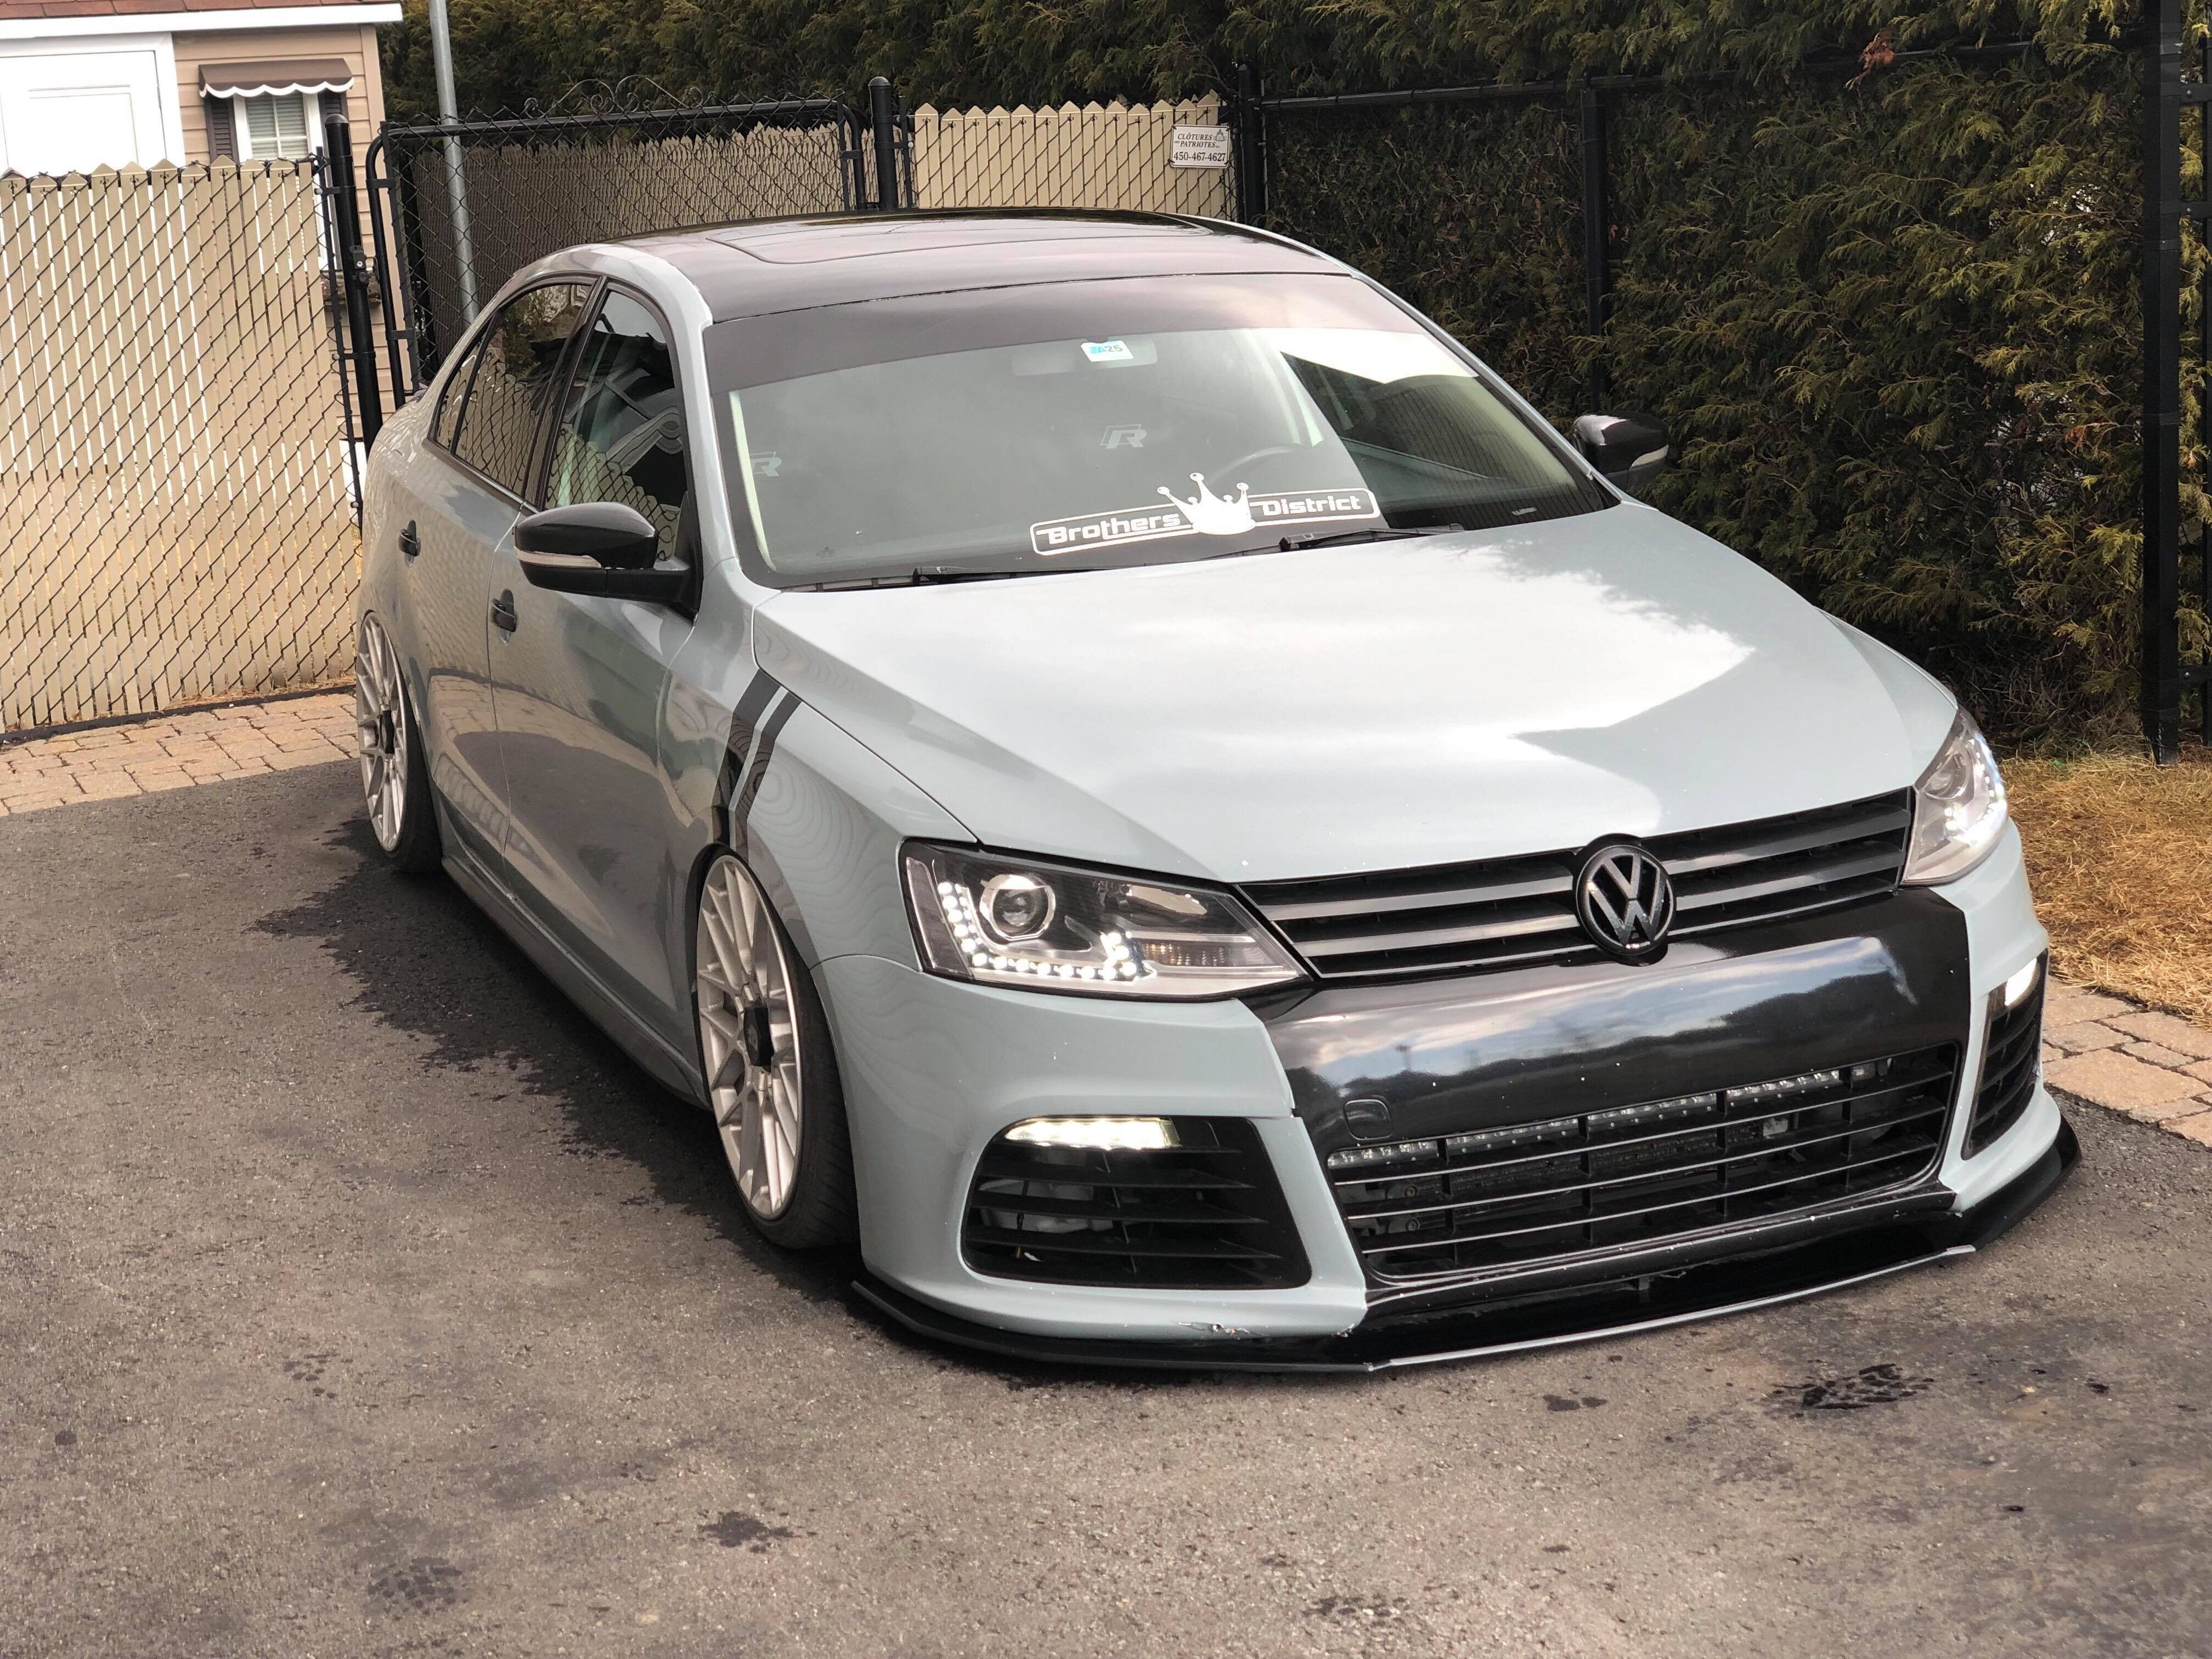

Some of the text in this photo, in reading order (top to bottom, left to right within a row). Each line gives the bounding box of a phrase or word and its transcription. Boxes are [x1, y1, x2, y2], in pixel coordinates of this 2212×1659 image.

[1177, 132, 1213, 140] CLÔTURES
[1173, 151, 1226, 161] 450-467-4627
[1036, 495, 1362, 545] Brothers District
